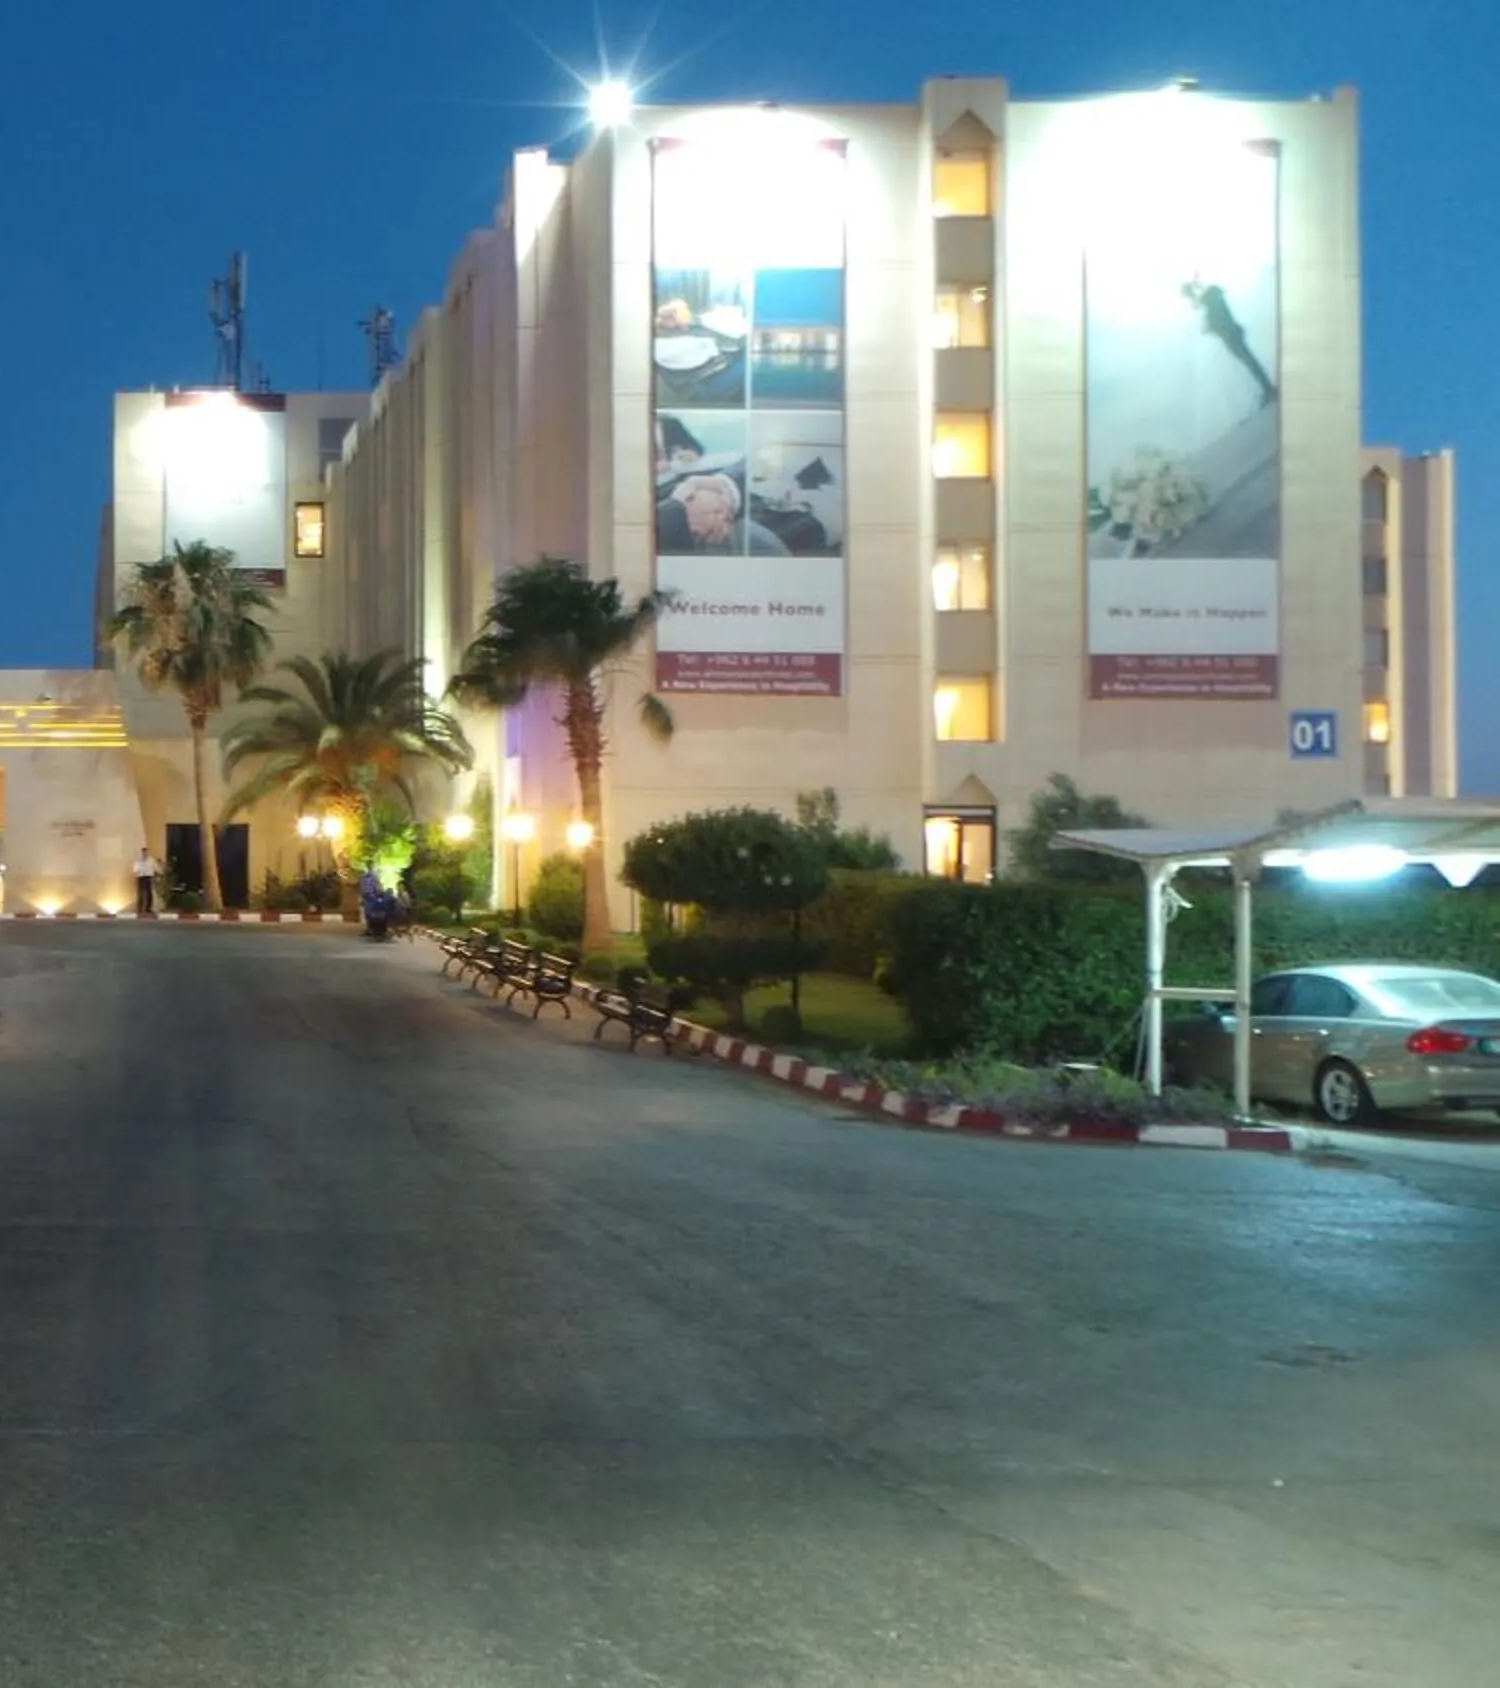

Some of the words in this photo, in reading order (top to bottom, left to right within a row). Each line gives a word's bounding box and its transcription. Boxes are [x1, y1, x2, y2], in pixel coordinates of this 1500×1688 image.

[668, 601, 761, 617] Welcome
[768, 601, 826, 617] Home
[1293, 719, 1331, 750] 01
